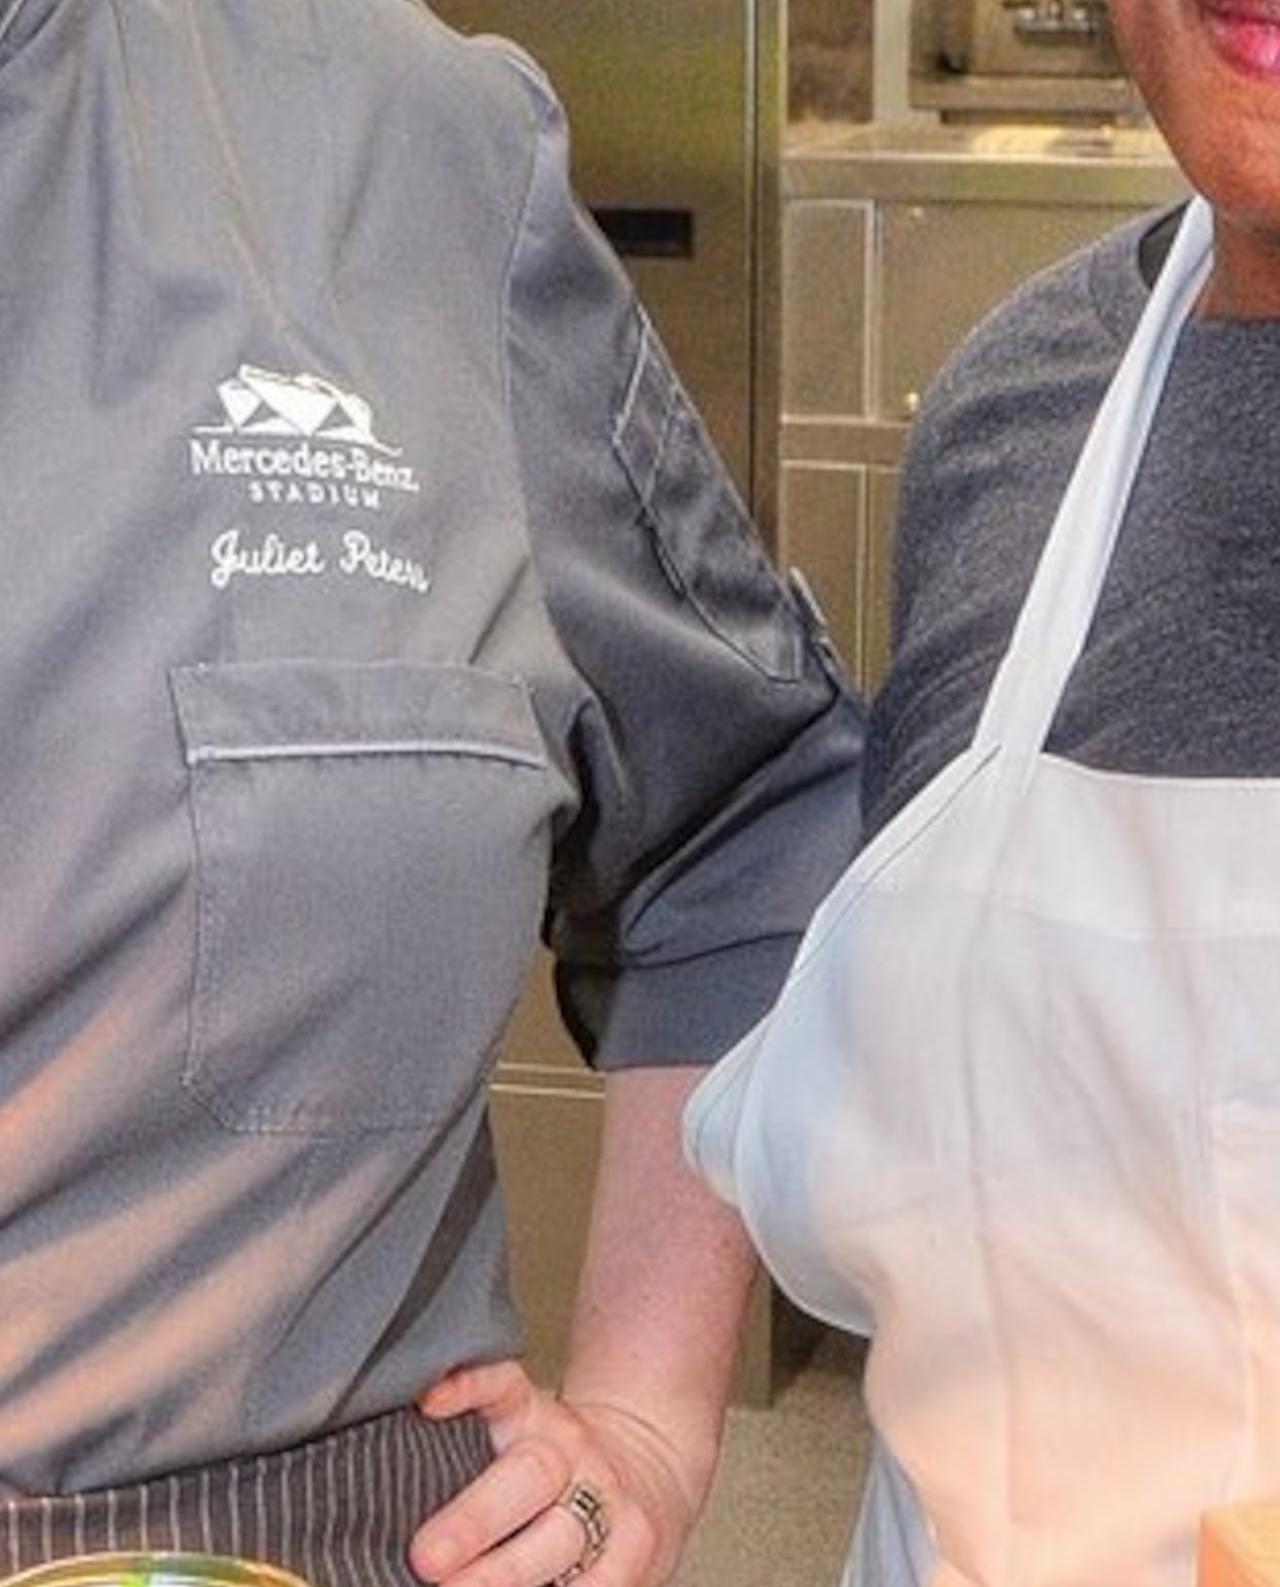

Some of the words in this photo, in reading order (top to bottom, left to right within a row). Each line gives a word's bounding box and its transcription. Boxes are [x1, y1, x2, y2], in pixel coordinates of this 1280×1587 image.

[189, 439, 420, 493] Mercedes-Benz
[248, 479, 380, 509] STADIUM
[210, 528, 326, 590] Juliet
